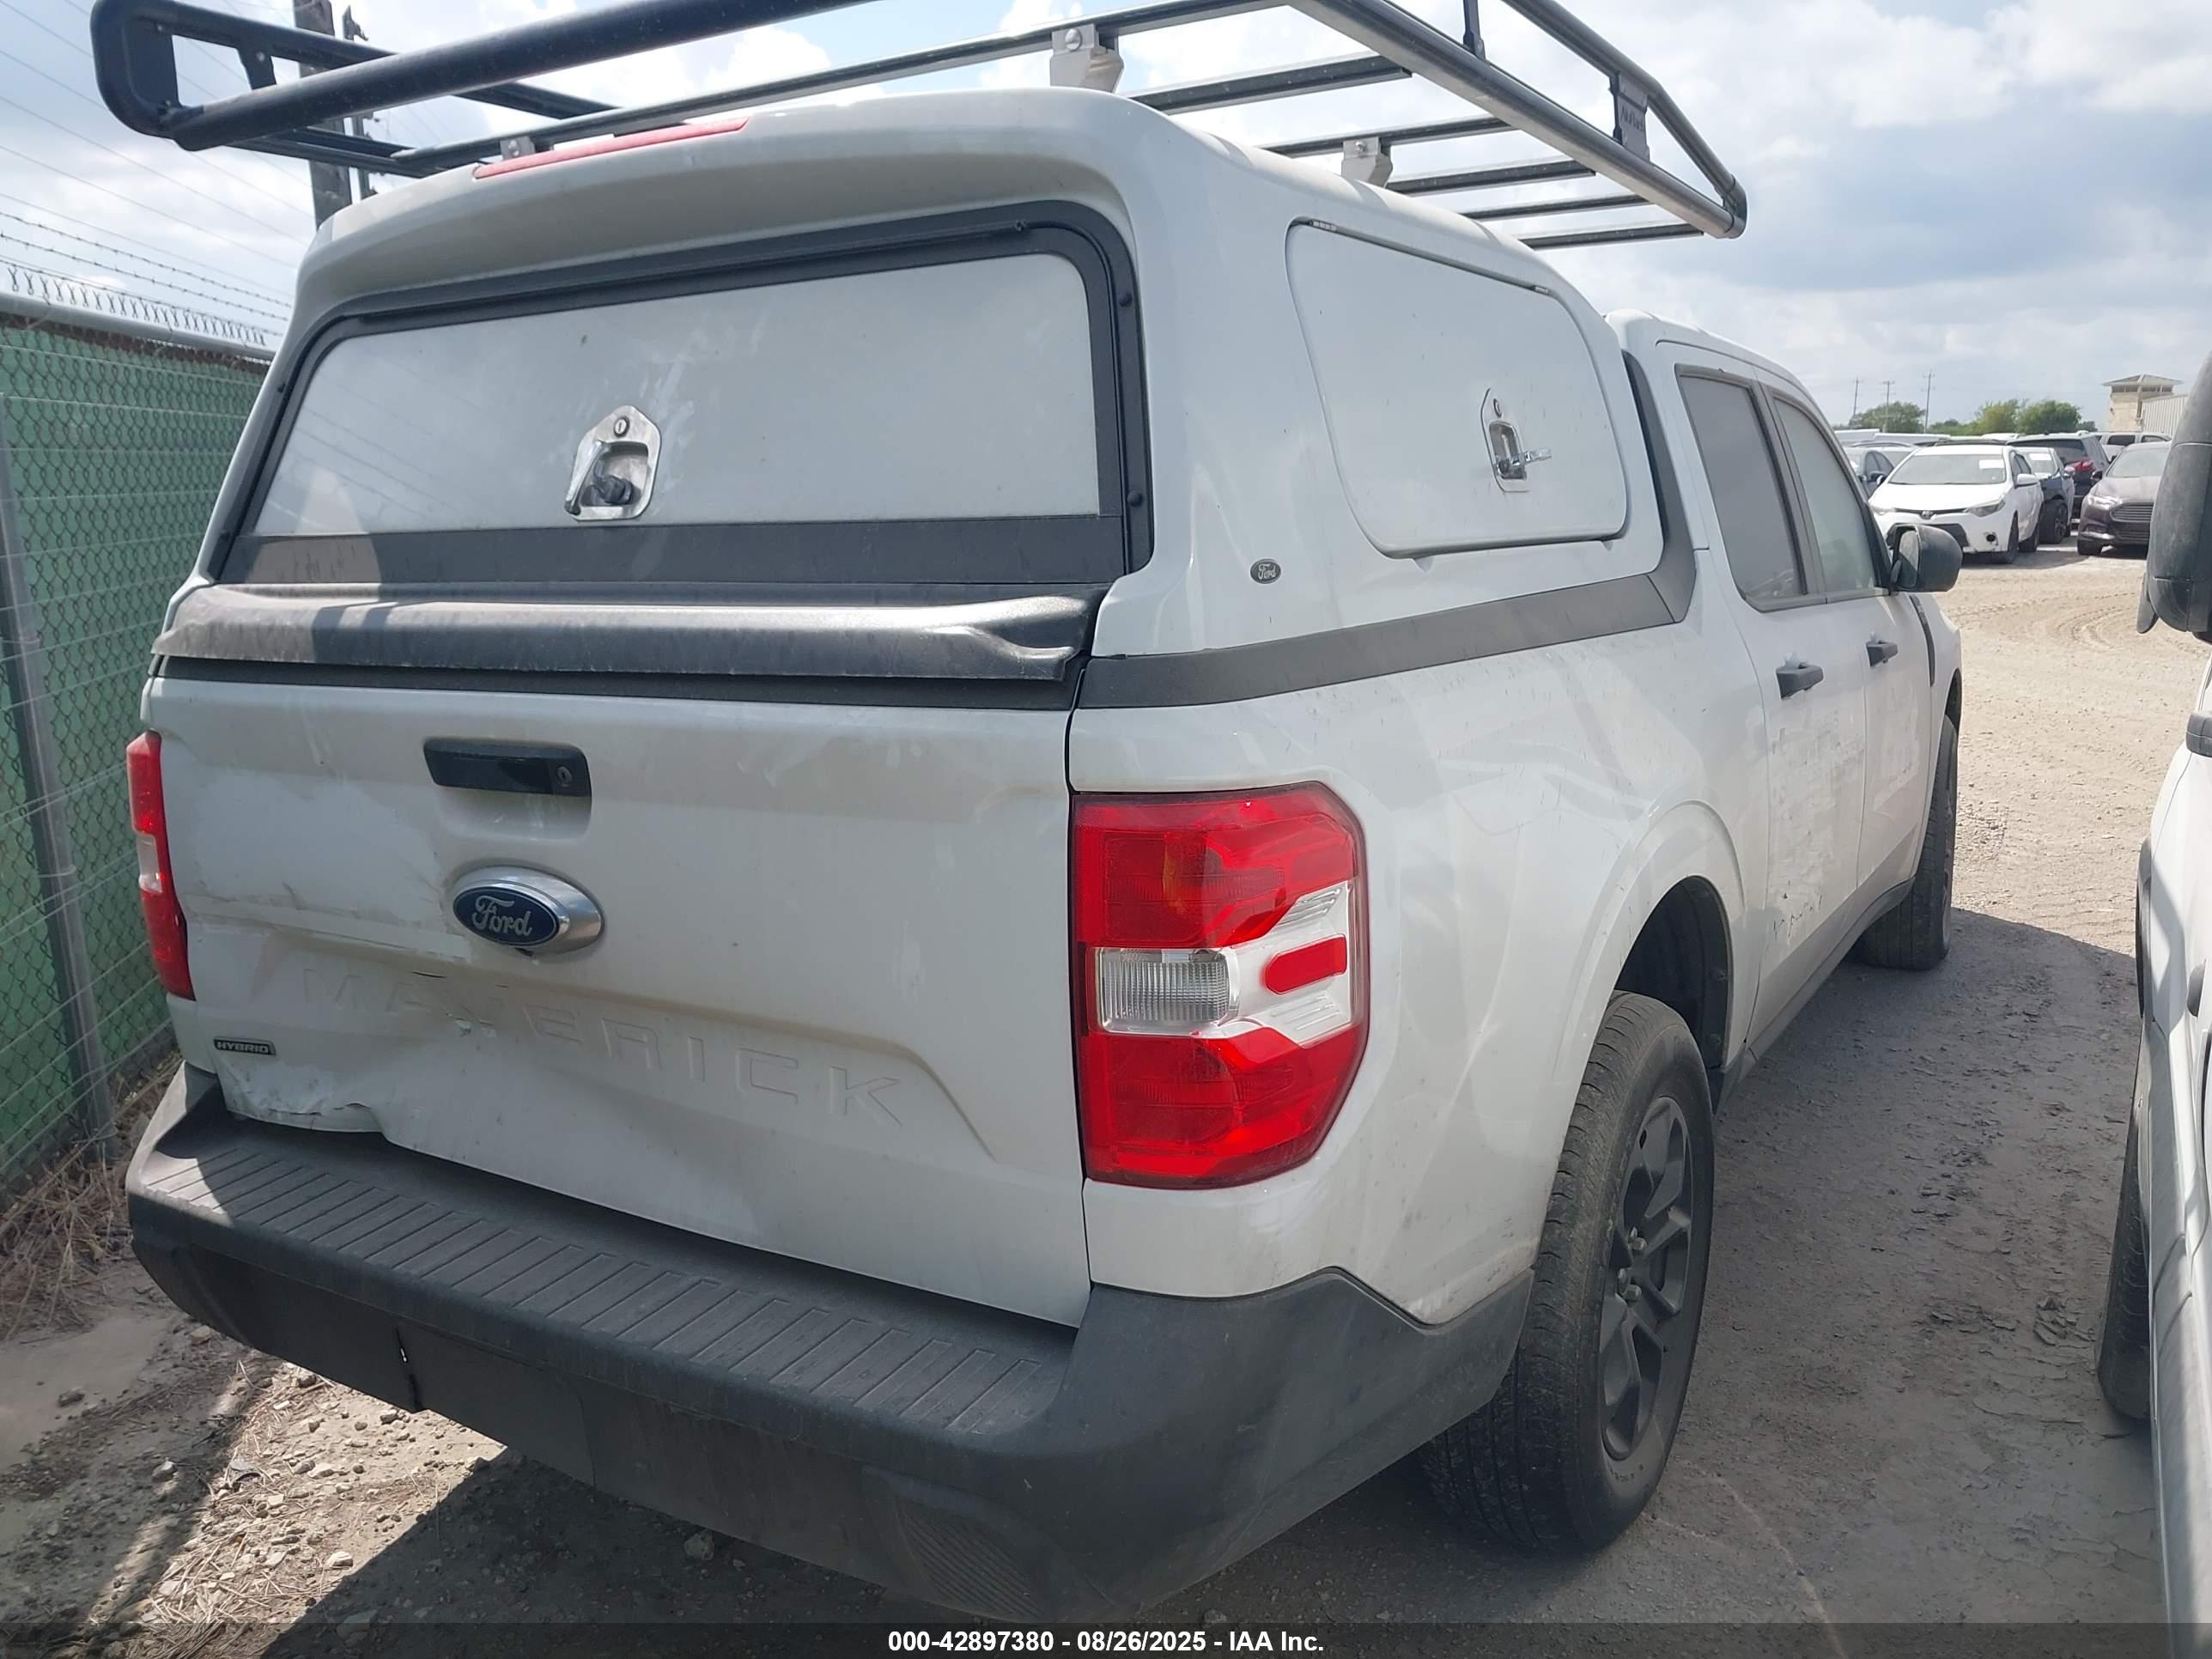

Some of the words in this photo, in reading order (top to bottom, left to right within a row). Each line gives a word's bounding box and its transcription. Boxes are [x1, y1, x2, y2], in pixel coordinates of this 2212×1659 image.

[1257, 562, 1277, 580] Ford
[471, 895, 533, 936] Ford
[216, 1041, 270, 1054] HYBRID
